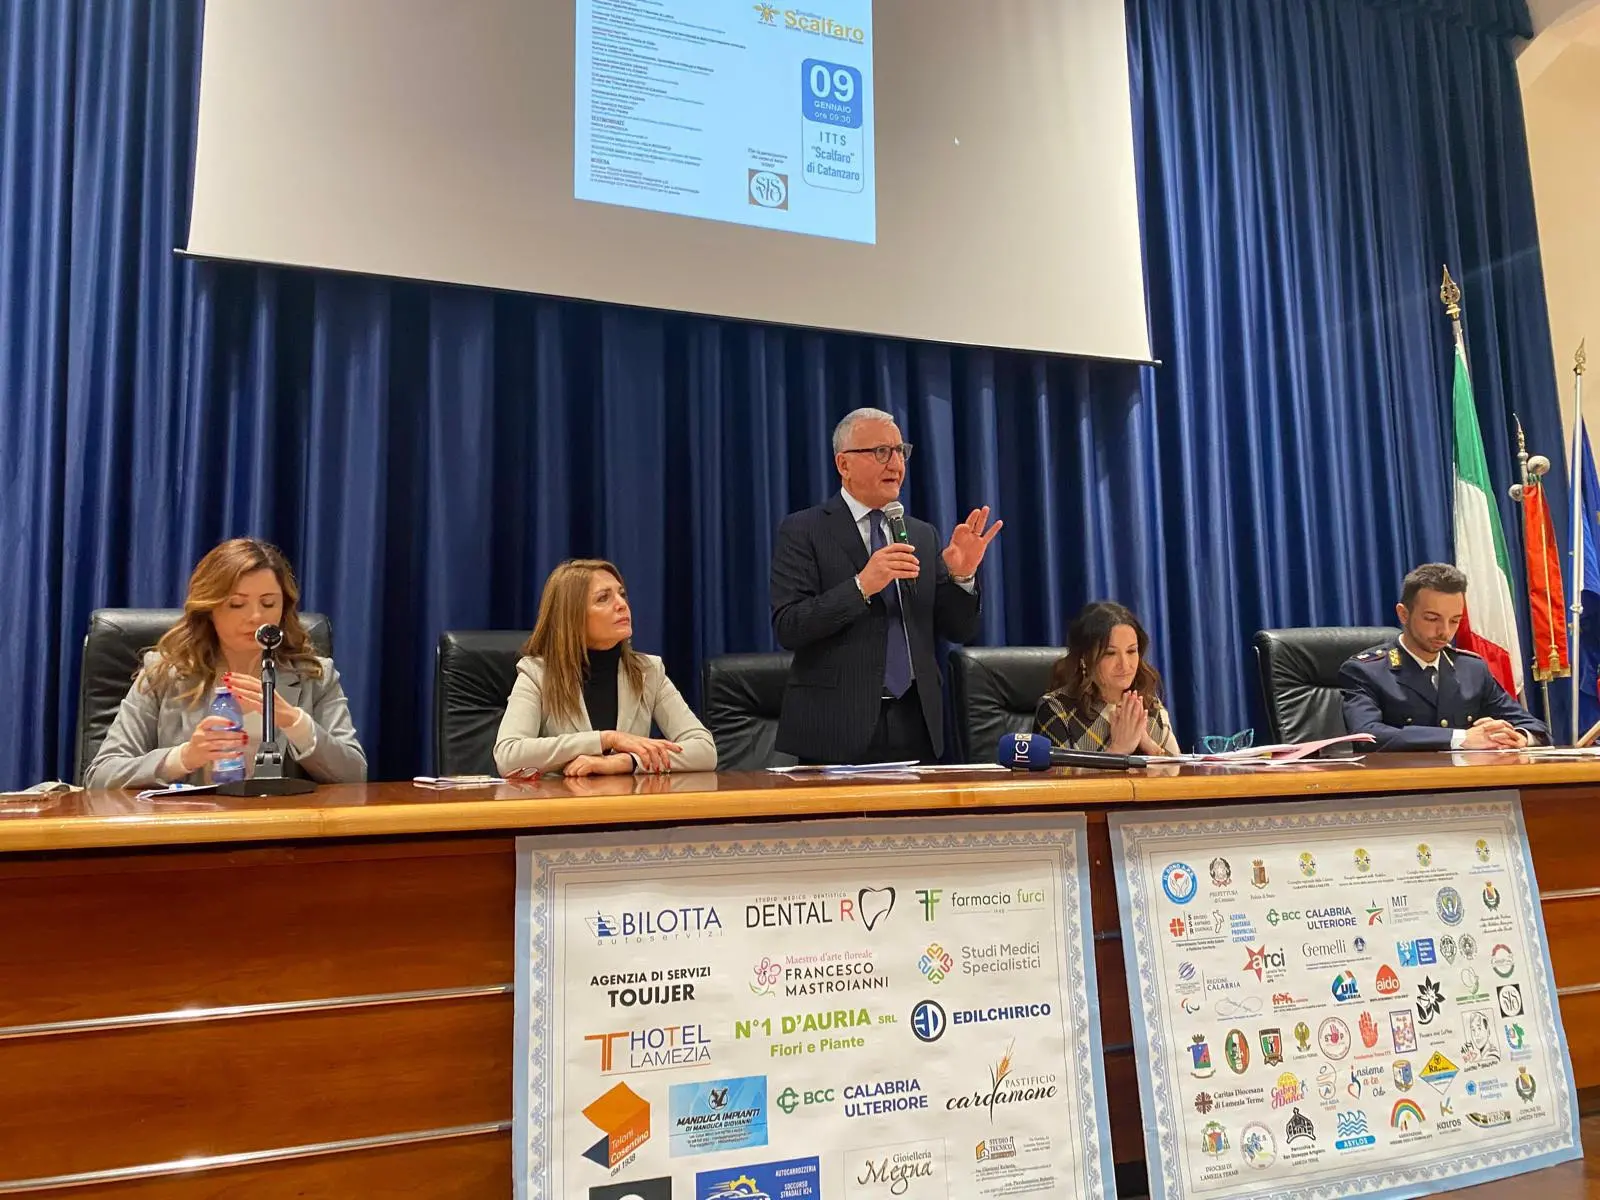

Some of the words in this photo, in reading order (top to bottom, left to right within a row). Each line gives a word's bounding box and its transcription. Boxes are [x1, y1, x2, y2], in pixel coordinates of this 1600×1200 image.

[784, 10, 864, 41] Scalfaro
[810, 64, 854, 102] 09
[814, 100, 851, 113] GENNAIO
[814, 111, 828, 119] ore
[807, 162, 815, 173] di
[817, 163, 860, 181] Catanzaro
[952, 892, 1011, 907] farmacia
[1016, 889, 1045, 904] furci
[1391, 895, 1408, 907] MIT
[622, 906, 723, 936] BILOTTA
[746, 901, 833, 928] DENTAL
[840, 899, 855, 921] R
[1281, 911, 1301, 921] BCC
[1305, 907, 1352, 919] CALABRIA
[1307, 917, 1357, 930] ULTERIORE
[785, 953, 818, 965] Maestro
[819, 951, 843, 964] d'arte
[844, 949, 873, 962] floreale
[961, 945, 998, 960] Studi
[1000, 941, 1041, 957] Medici
[1302, 940, 1347, 957] Gemelli
[962, 956, 1042, 977] Specialistici
[1252, 947, 1286, 970] arci
[590, 970, 648, 986] AGENZIA
[651, 969, 663, 982] DI
[667, 966, 711, 980] SERVIZI
[785, 962, 874, 981] FRANCESCO
[785, 976, 889, 997] MASTROIANNI
[1207, 982, 1241, 991] CALABRIA
[1341, 983, 1359, 995] UIL
[1376, 977, 1400, 991] aido
[608, 983, 695, 1008] TOUIJER
[781, 1008, 872, 1035] D'AURIA
[878, 1014, 897, 1025] SRL
[953, 1003, 1051, 1025] EDILCHIRICO
[630, 1024, 711, 1050] HOTEL
[770, 1042, 803, 1057] Fiori
[807, 1043, 816, 1053] e
[820, 1036, 865, 1051] Piante
[630, 1045, 711, 1069] LAMEZIA
[1005, 1074, 1056, 1089] PASTIFICIO
[1370, 1076, 1379, 1086] te
[803, 1088, 835, 1105] BCC
[843, 1078, 921, 1100] CALABRIA
[1235, 1088, 1264, 1096] Diocesana
[1270, 1085, 1297, 1099] Gabry
[845, 1094, 929, 1118] ULTERIORE
[946, 1080, 1057, 1124] cardamone
[1222, 1099, 1245, 1108] Lamezia
[1271, 1092, 1305, 1110] Dance
[676, 1112, 722, 1127] MANDUCA
[722, 1108, 760, 1121] IMPIANTI
[610, 1130, 649, 1164] Cosentino
[611, 1129, 634, 1148] Teloni
[989, 1137, 1009, 1145] STUDIO
[990, 1143, 1013, 1152] TECNICO
[1343, 1138, 1368, 1148] ASYLOS
[892, 1150, 932, 1163] Gioielleria
[610, 1165, 621, 1177] dal
[857, 1158, 934, 1196] Megna
[1200, 1172, 1222, 1181] LAMEZIA
[1222, 1169, 1239, 1178] TERME
[1205, 1164, 1226, 1172] DIOCESI
